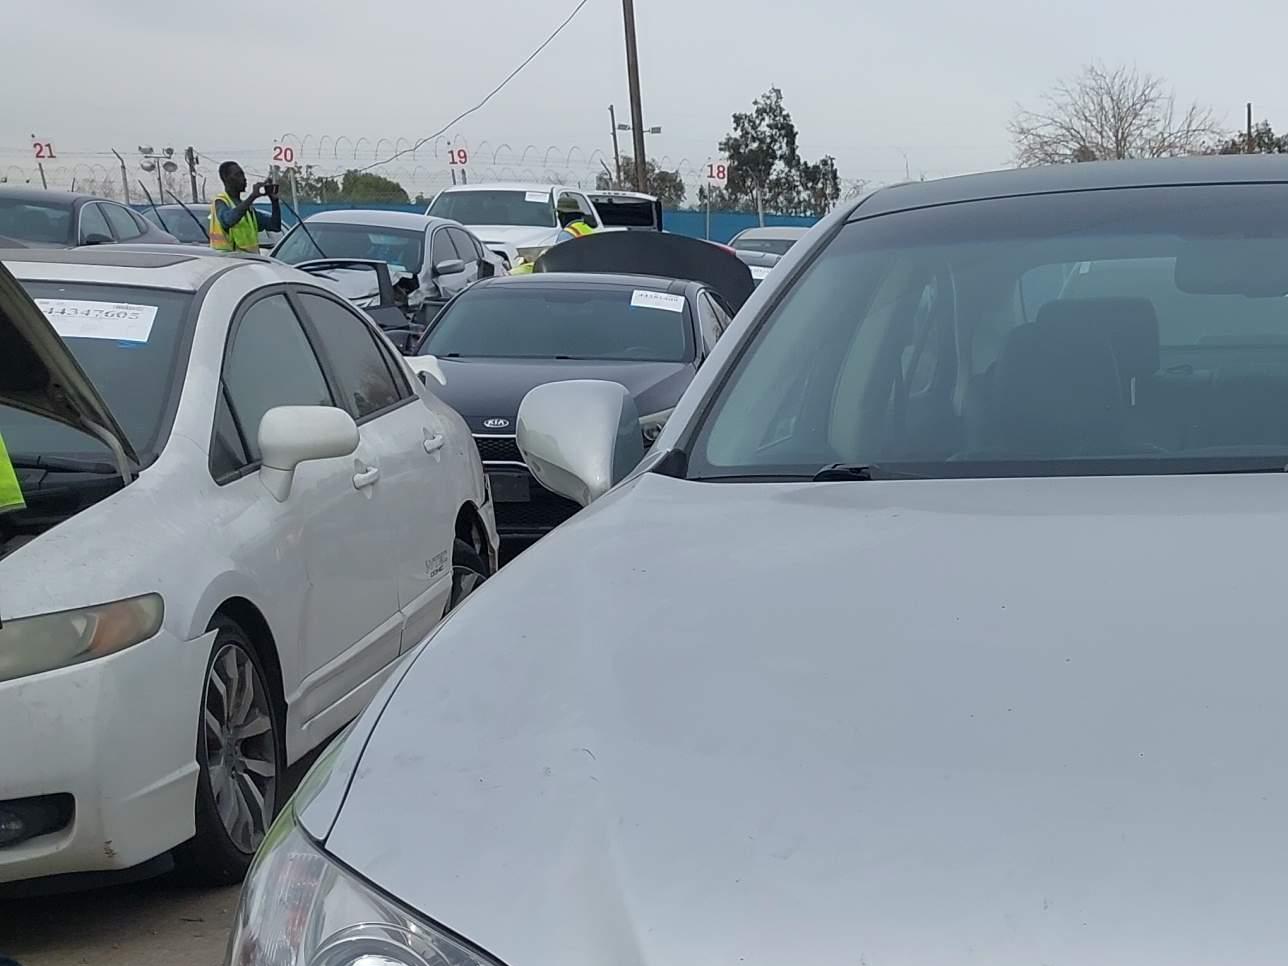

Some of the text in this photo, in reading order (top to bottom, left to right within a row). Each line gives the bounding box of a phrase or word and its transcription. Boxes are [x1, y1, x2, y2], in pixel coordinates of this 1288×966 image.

[33, 142, 57, 159] 21
[273, 146, 294, 163] 20
[448, 149, 468, 165] 19
[706, 164, 726, 180] 18
